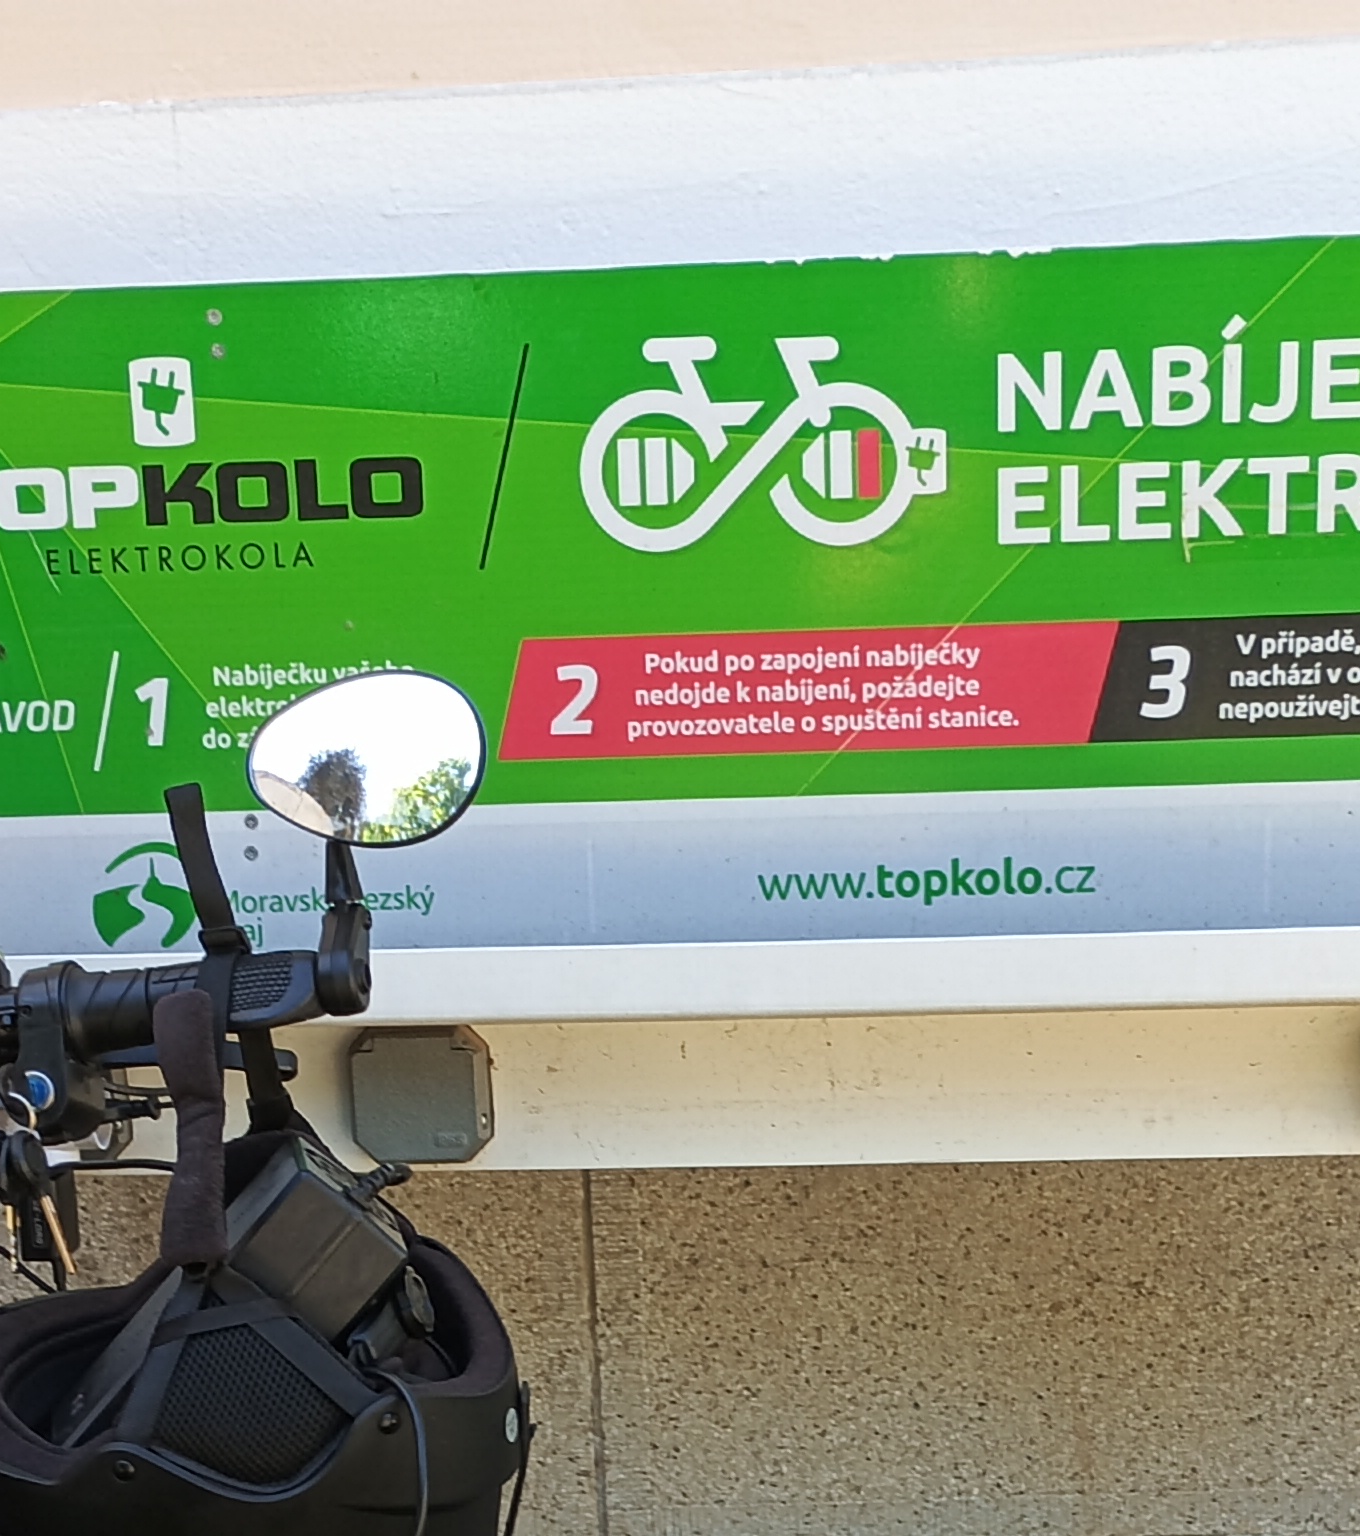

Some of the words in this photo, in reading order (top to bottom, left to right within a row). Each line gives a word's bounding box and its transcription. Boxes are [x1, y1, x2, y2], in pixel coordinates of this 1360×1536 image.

[46, 541, 315, 577] ELEKTROKOLA
[644, 649, 719, 676] Pokud
[724, 653, 755, 680] po
[760, 643, 861, 677] zapojení
[866, 641, 981, 672] nabíječky
[1237, 633, 1255, 656] V
[212, 662, 328, 690] Nabíječku
[635, 680, 730, 709] nedojde
[736, 679, 752, 702] k
[755, 675, 857, 706] nabíjení,
[861, 673, 981, 705] požádejte
[1139, 645, 1191, 720] 3
[1229, 662, 1322, 689] nachází
[1326, 668, 1342, 686] v
[134, 677, 169, 747] 1
[549, 663, 599, 736] 2
[202, 727, 232, 750] do
[627, 711, 795, 741] provozovatele
[801, 714, 817, 733] o
[822, 706, 924, 736] spuštění
[928, 704, 1020, 730] stanice.
[758, 856, 1096, 905] www.topkolo.cz
